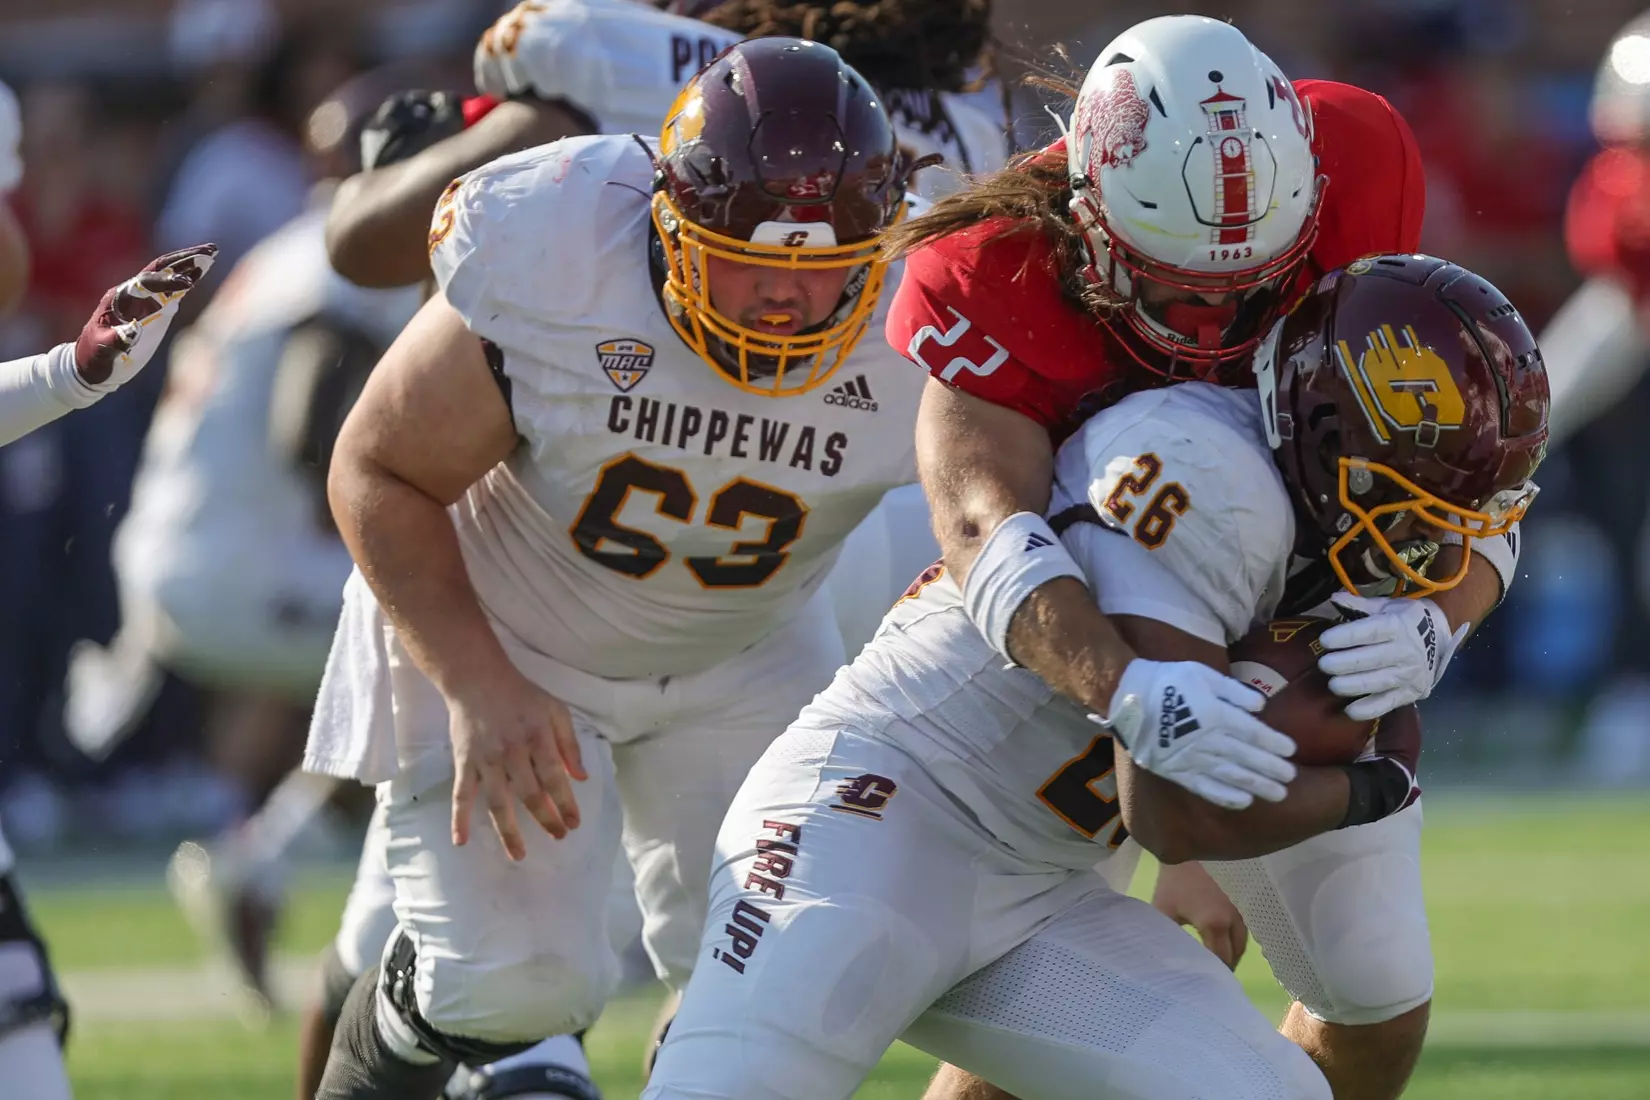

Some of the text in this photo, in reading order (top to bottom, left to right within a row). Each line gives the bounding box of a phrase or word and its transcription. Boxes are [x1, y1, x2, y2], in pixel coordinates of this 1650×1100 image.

[1208, 246, 1252, 261] 1963
[601, 355, 652, 369] MAC
[607, 395, 848, 477] CHIPPEWAS
[823, 393, 878, 412] adidas
[568, 451, 812, 589] 63
[1104, 452, 1190, 550] 26
[1159, 685, 1177, 748] adidas
[713, 820, 801, 974] FIRE UP!
